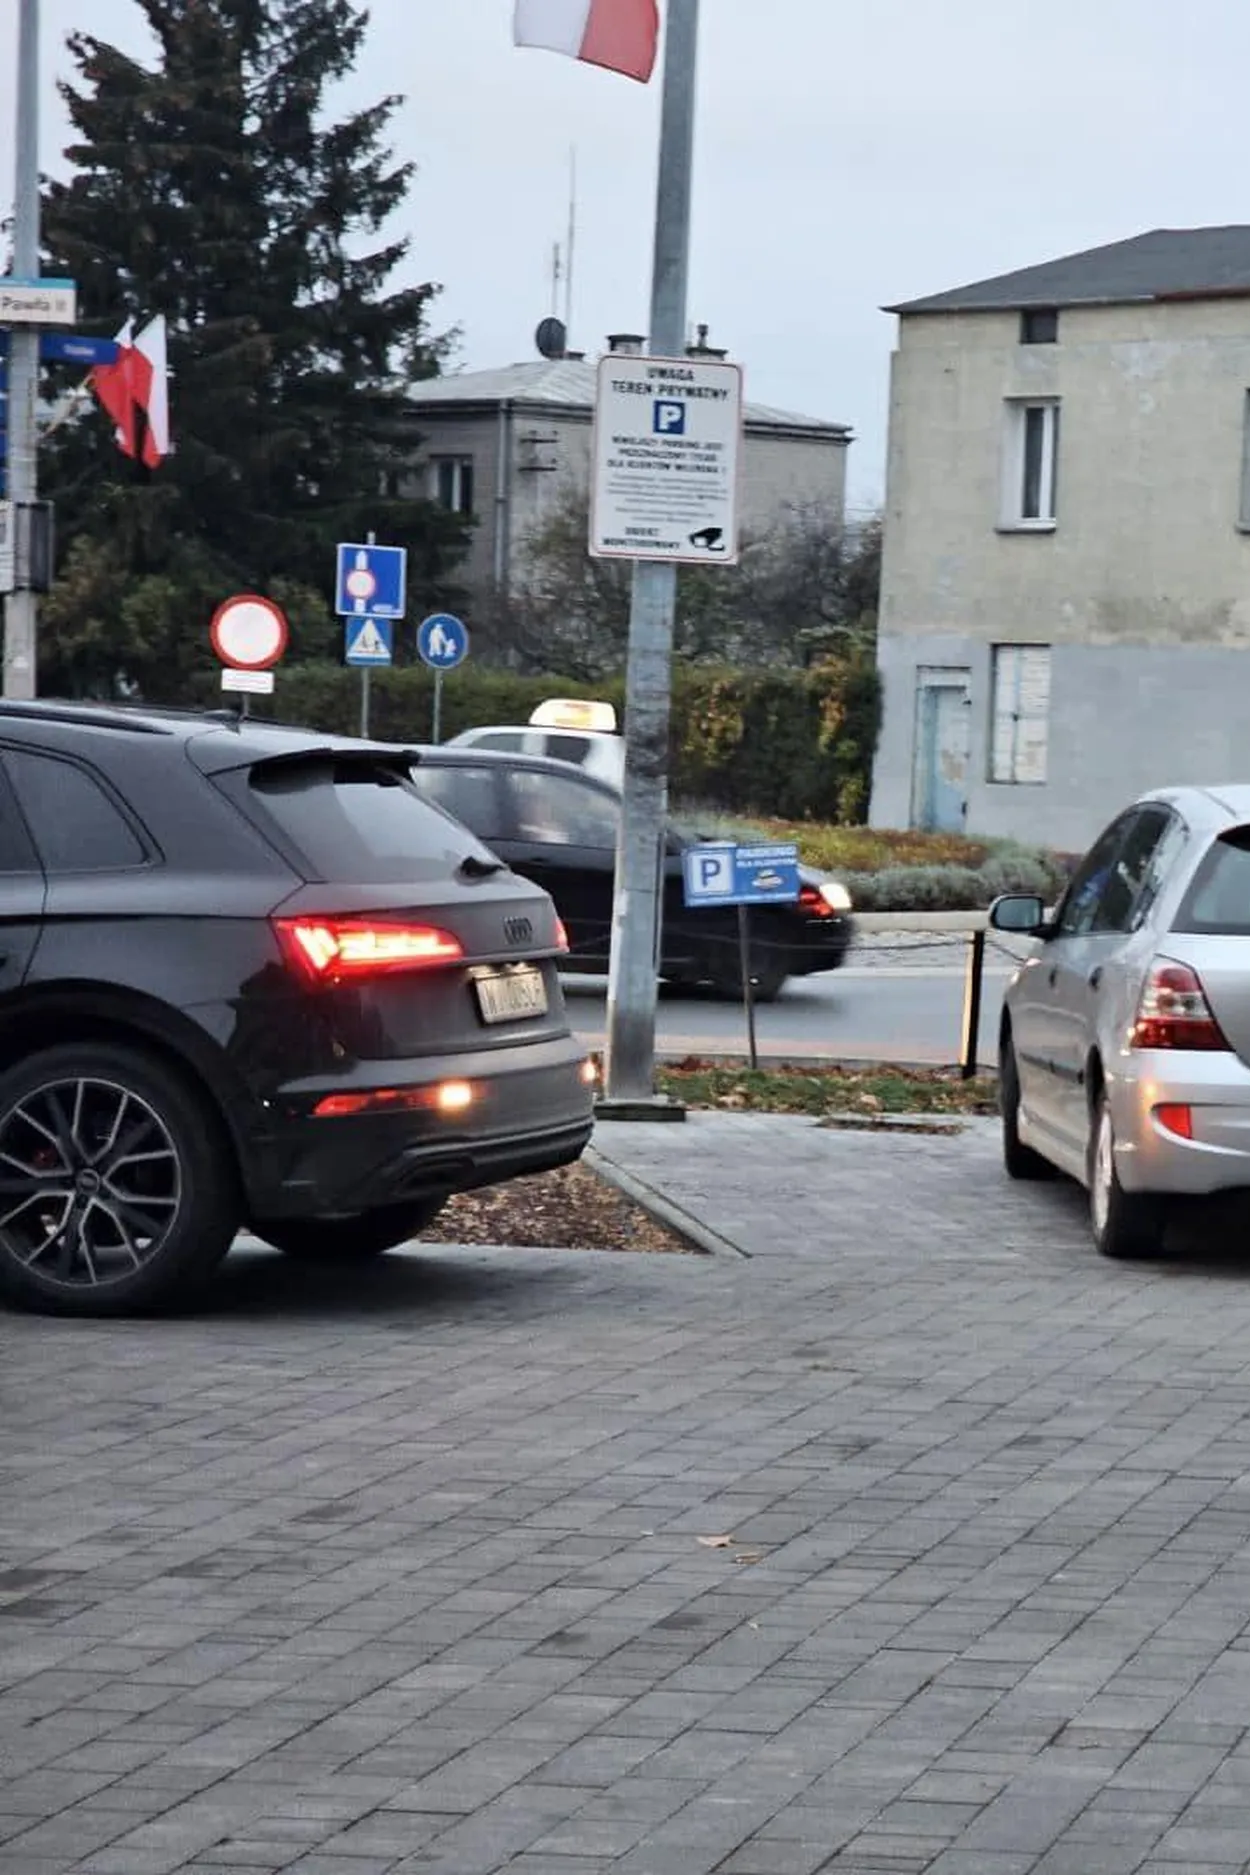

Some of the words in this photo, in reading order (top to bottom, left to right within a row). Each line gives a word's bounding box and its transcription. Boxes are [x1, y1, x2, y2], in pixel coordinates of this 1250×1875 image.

[649, 367, 695, 381] UWAGA
[611, 379, 653, 394] TEREN
[658, 385, 728, 400] PRYWATNY
[658, 404, 682, 430] P
[700, 858, 721, 889] P
